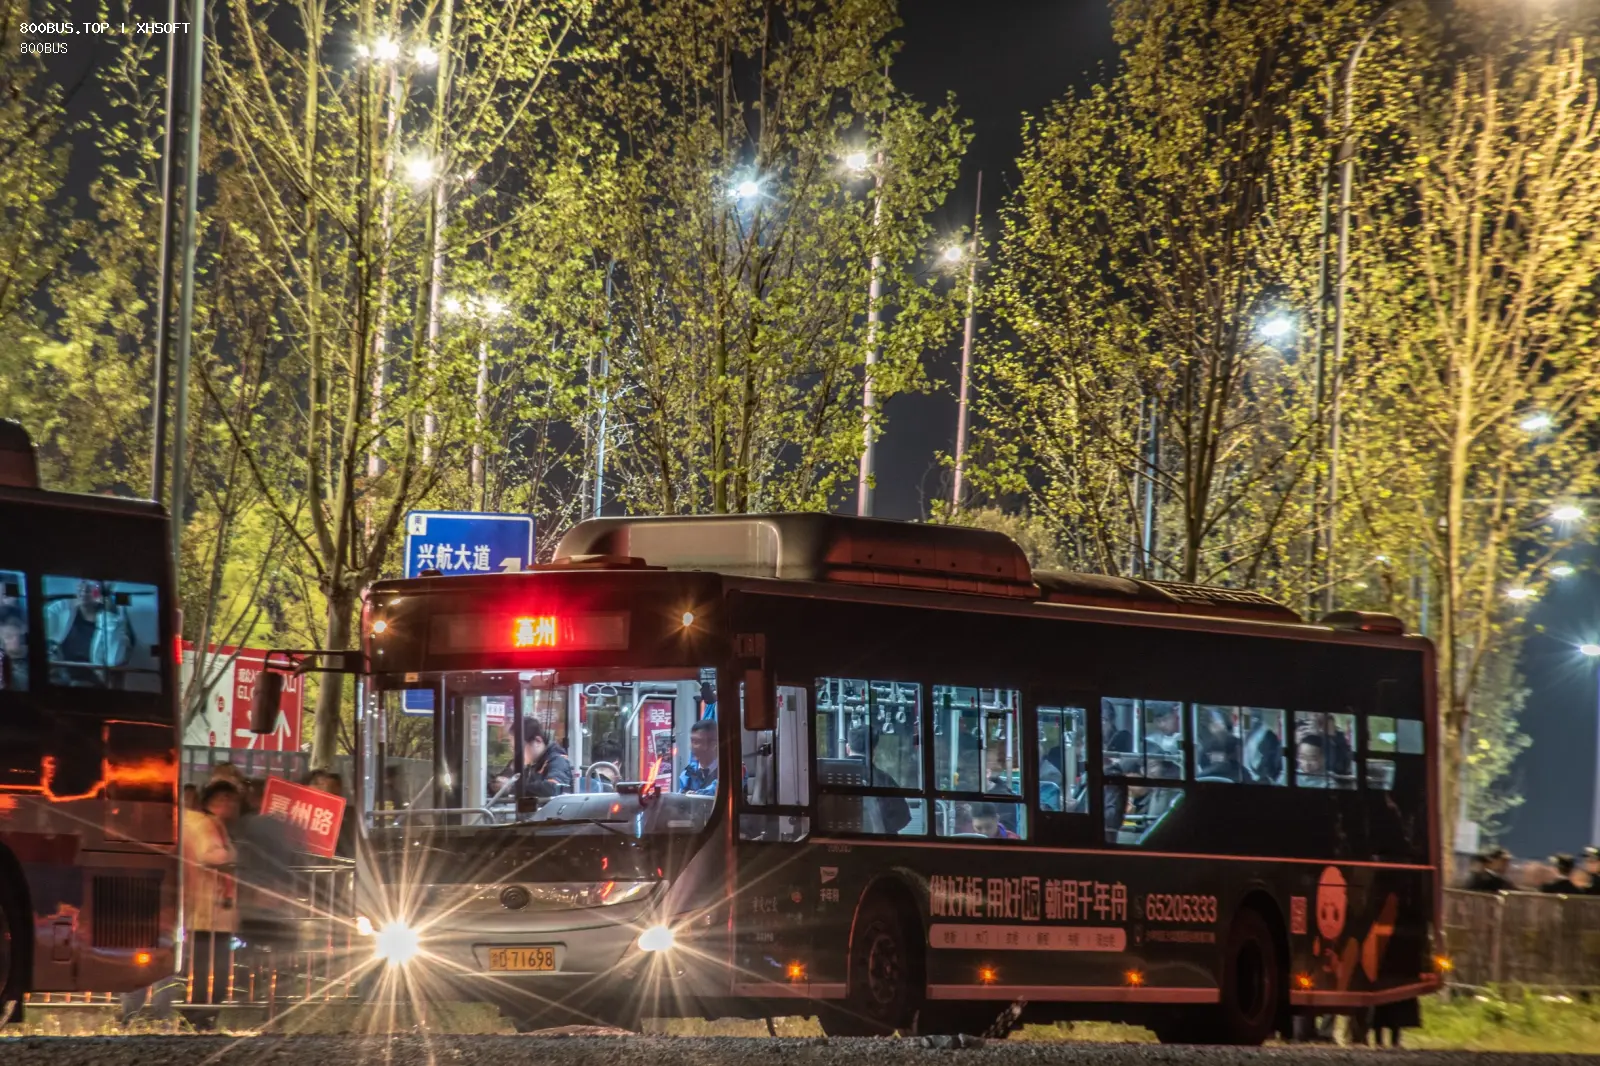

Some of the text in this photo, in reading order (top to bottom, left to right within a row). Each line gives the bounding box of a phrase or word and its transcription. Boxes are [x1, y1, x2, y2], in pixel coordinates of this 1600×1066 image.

[416, 543, 492, 572] 兴航大道
[1045, 878, 1128, 921] 就用千年舟
[1145, 892, 1218, 924] 65205333
